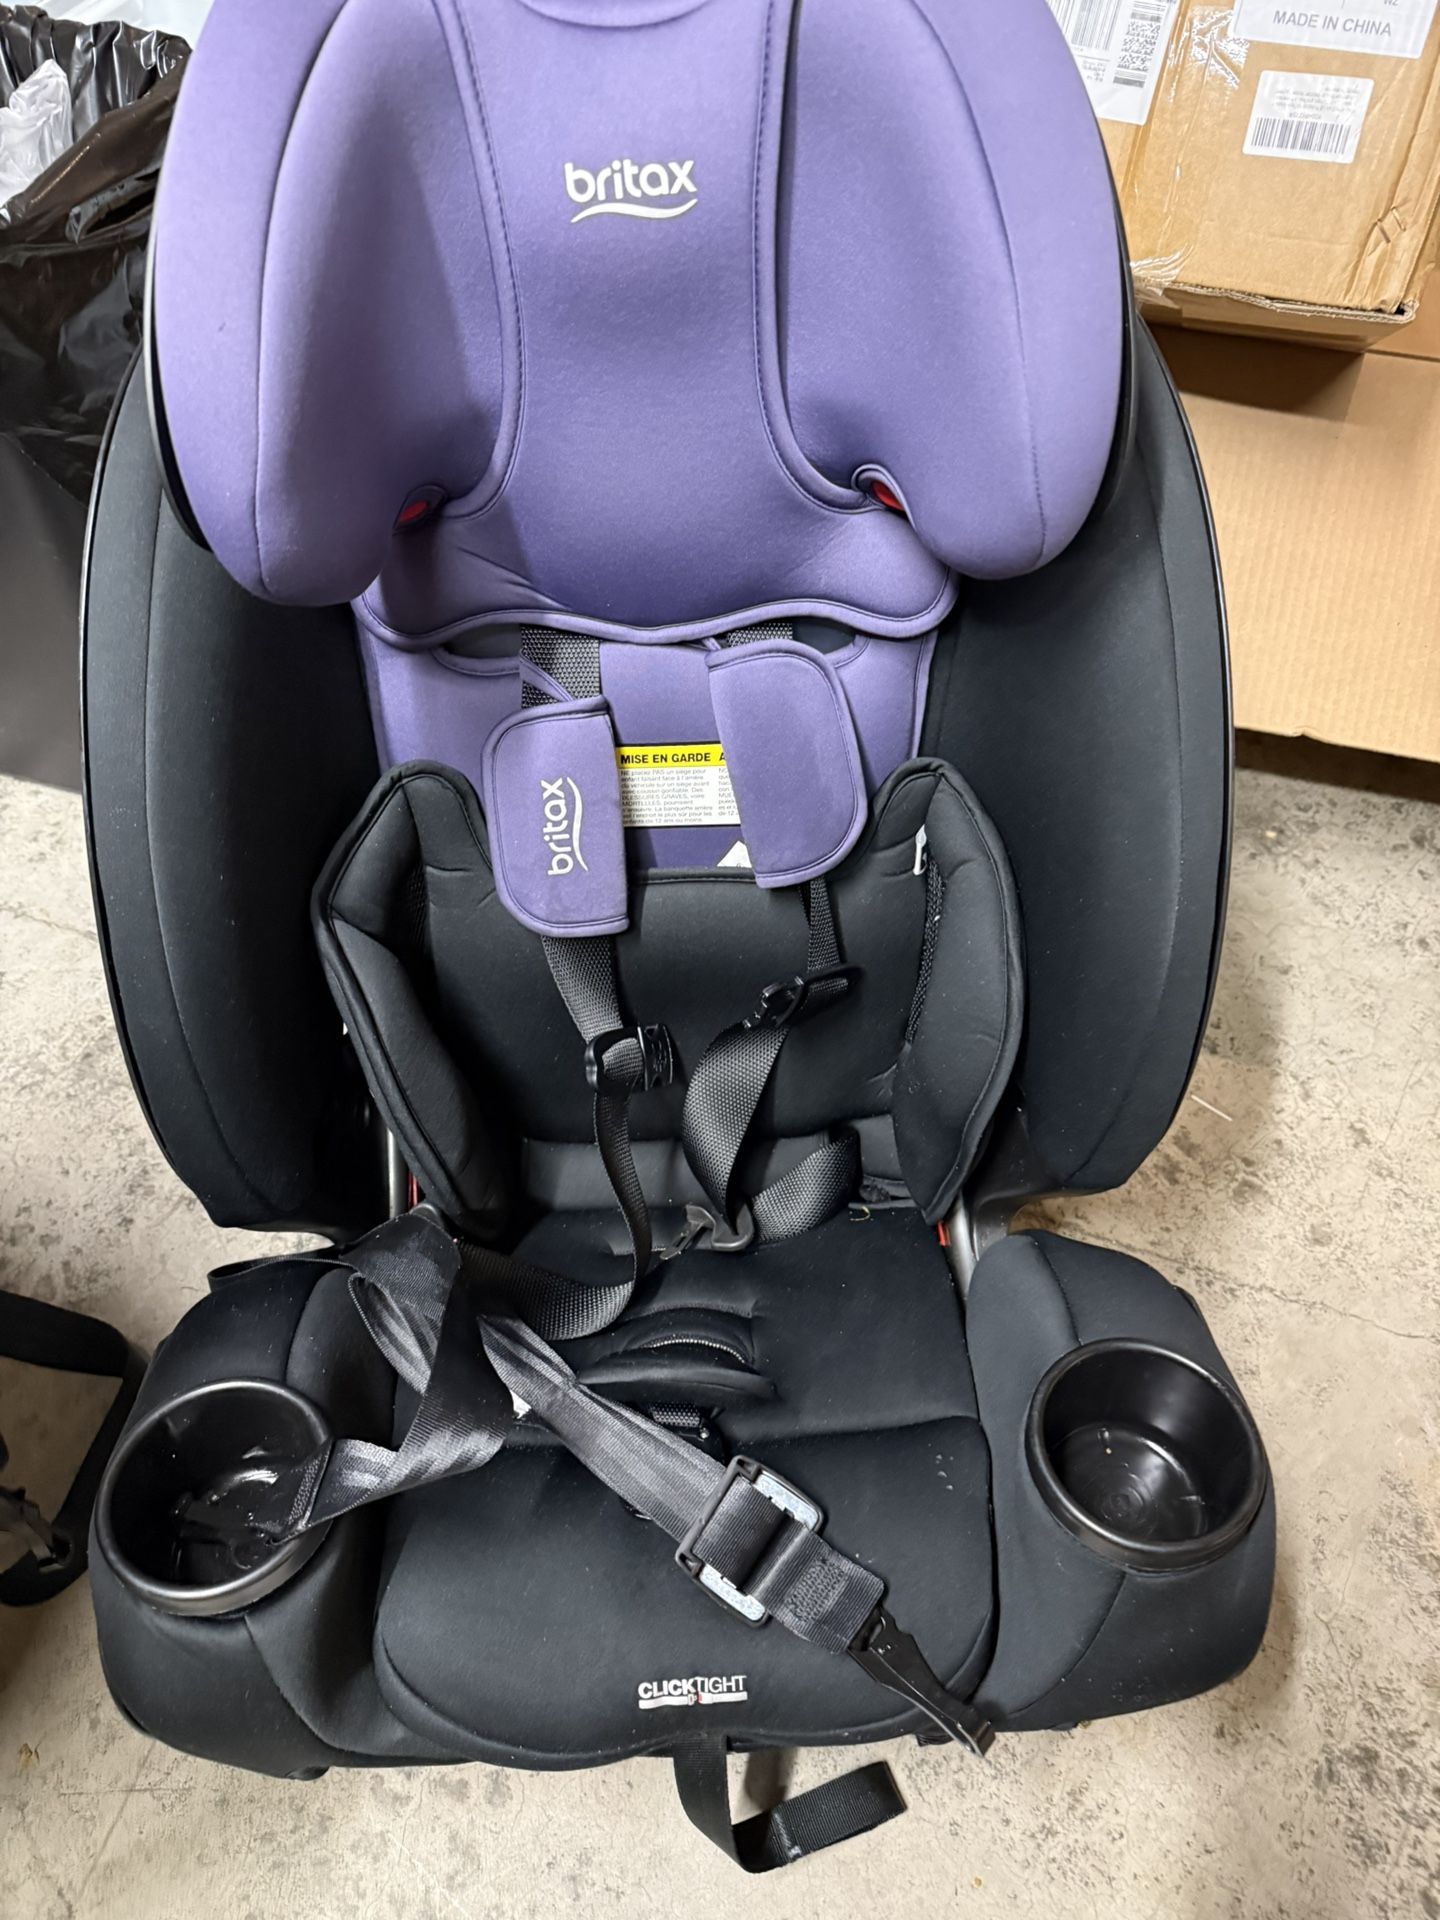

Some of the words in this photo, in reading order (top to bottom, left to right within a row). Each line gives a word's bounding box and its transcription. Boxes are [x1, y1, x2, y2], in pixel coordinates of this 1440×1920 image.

[1272, 10, 1320, 29] MADE
[1322, 15, 1339, 31] IN
[1342, 18, 1392, 37] CHINA
[564, 158, 698, 203] britax
[620, 754, 649, 764] MISE
[652, 753, 668, 763] EN
[671, 752, 711, 763] GARDE
[541, 778, 574, 875] britax
[637, 1675, 747, 1699] CLICKTIGHT
